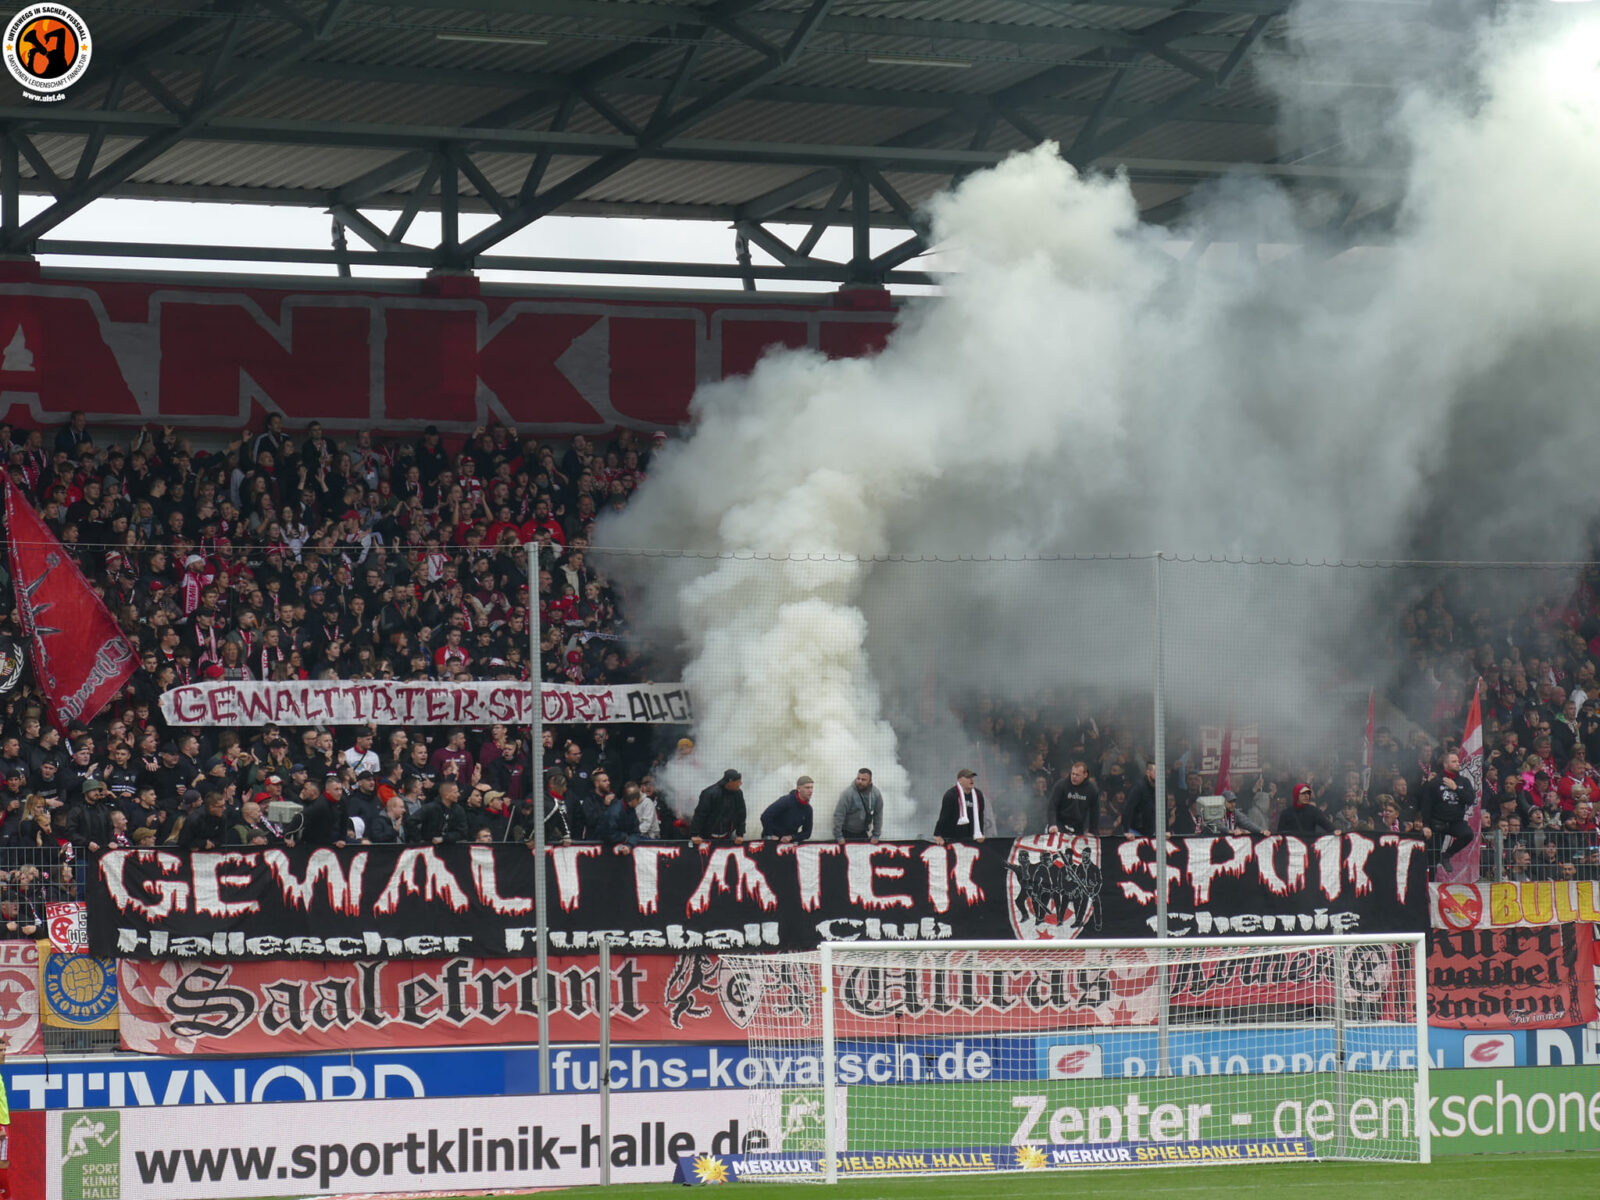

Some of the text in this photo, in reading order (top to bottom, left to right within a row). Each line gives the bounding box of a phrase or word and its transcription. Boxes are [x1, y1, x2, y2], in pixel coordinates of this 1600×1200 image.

[1117, 833, 1426, 906] SPORT
[47, 904, 73, 917] HFC
[117, 928, 473, 956] Hallescher
[815, 917, 952, 944] Club
[1146, 909, 1360, 938] Chemie
[0, 945, 39, 964] FC
[48, 974, 117, 1017] LOKOMOTIVE
[166, 958, 648, 1037] Saalefront
[1531, 1010, 1565, 1023] immer
[1011, 1094, 1212, 1146] Zepter
[800, 1140, 826, 1151] SPOR
[1053, 1142, 1307, 1164] MERKUR SPIELBANK HALLE
[82, 1163, 118, 1175] SPORT
[732, 1159, 813, 1175] MERKUR
[933, 1153, 994, 1169] HALLE
[82, 1175, 118, 1187] KLINIK
[82, 1187, 119, 1199] HALLE
